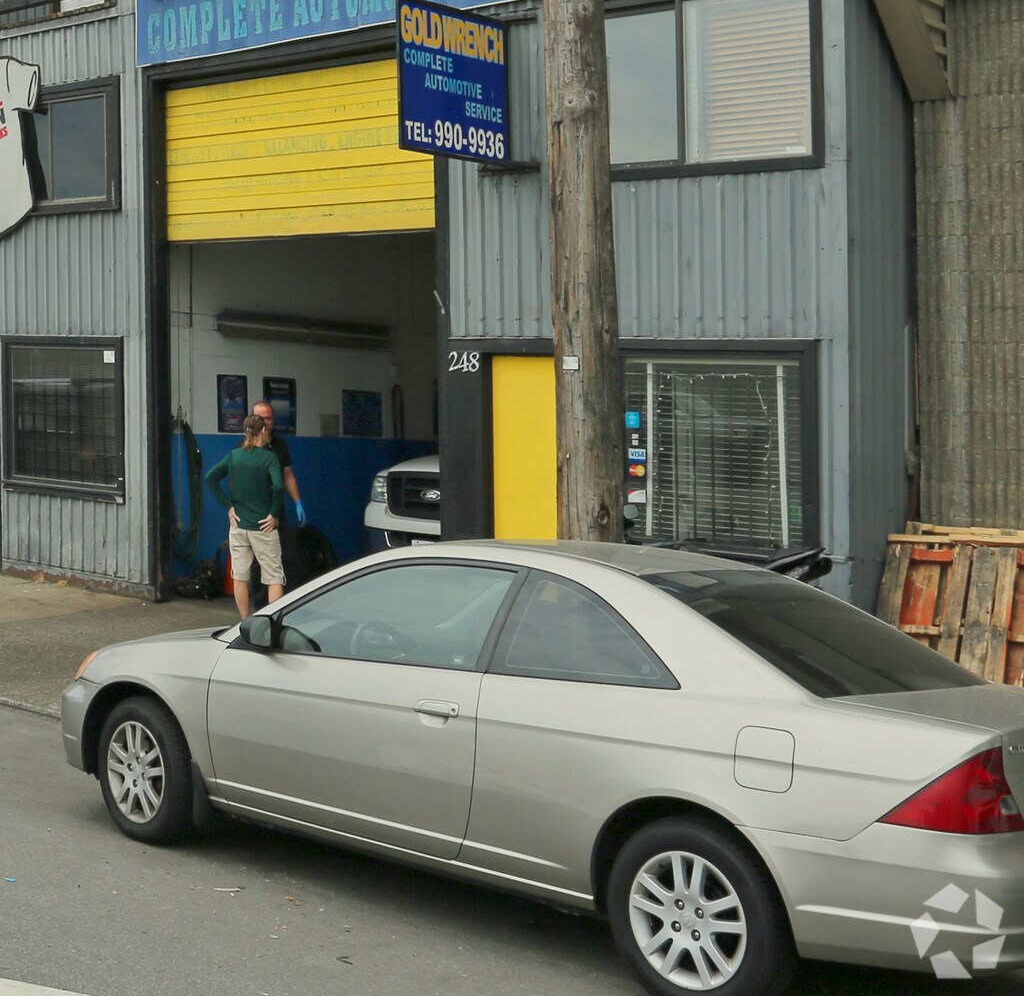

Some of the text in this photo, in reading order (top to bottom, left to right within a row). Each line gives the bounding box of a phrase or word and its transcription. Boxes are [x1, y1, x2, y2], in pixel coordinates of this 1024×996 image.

[403, 47, 454, 73] COMPLETE
[424, 72, 483, 100] AUTOMOTIVE
[465, 101, 503, 124] SERVICE
[405, 119, 505, 160] TEL: 990-9936
[448, 350, 480, 373] 248
